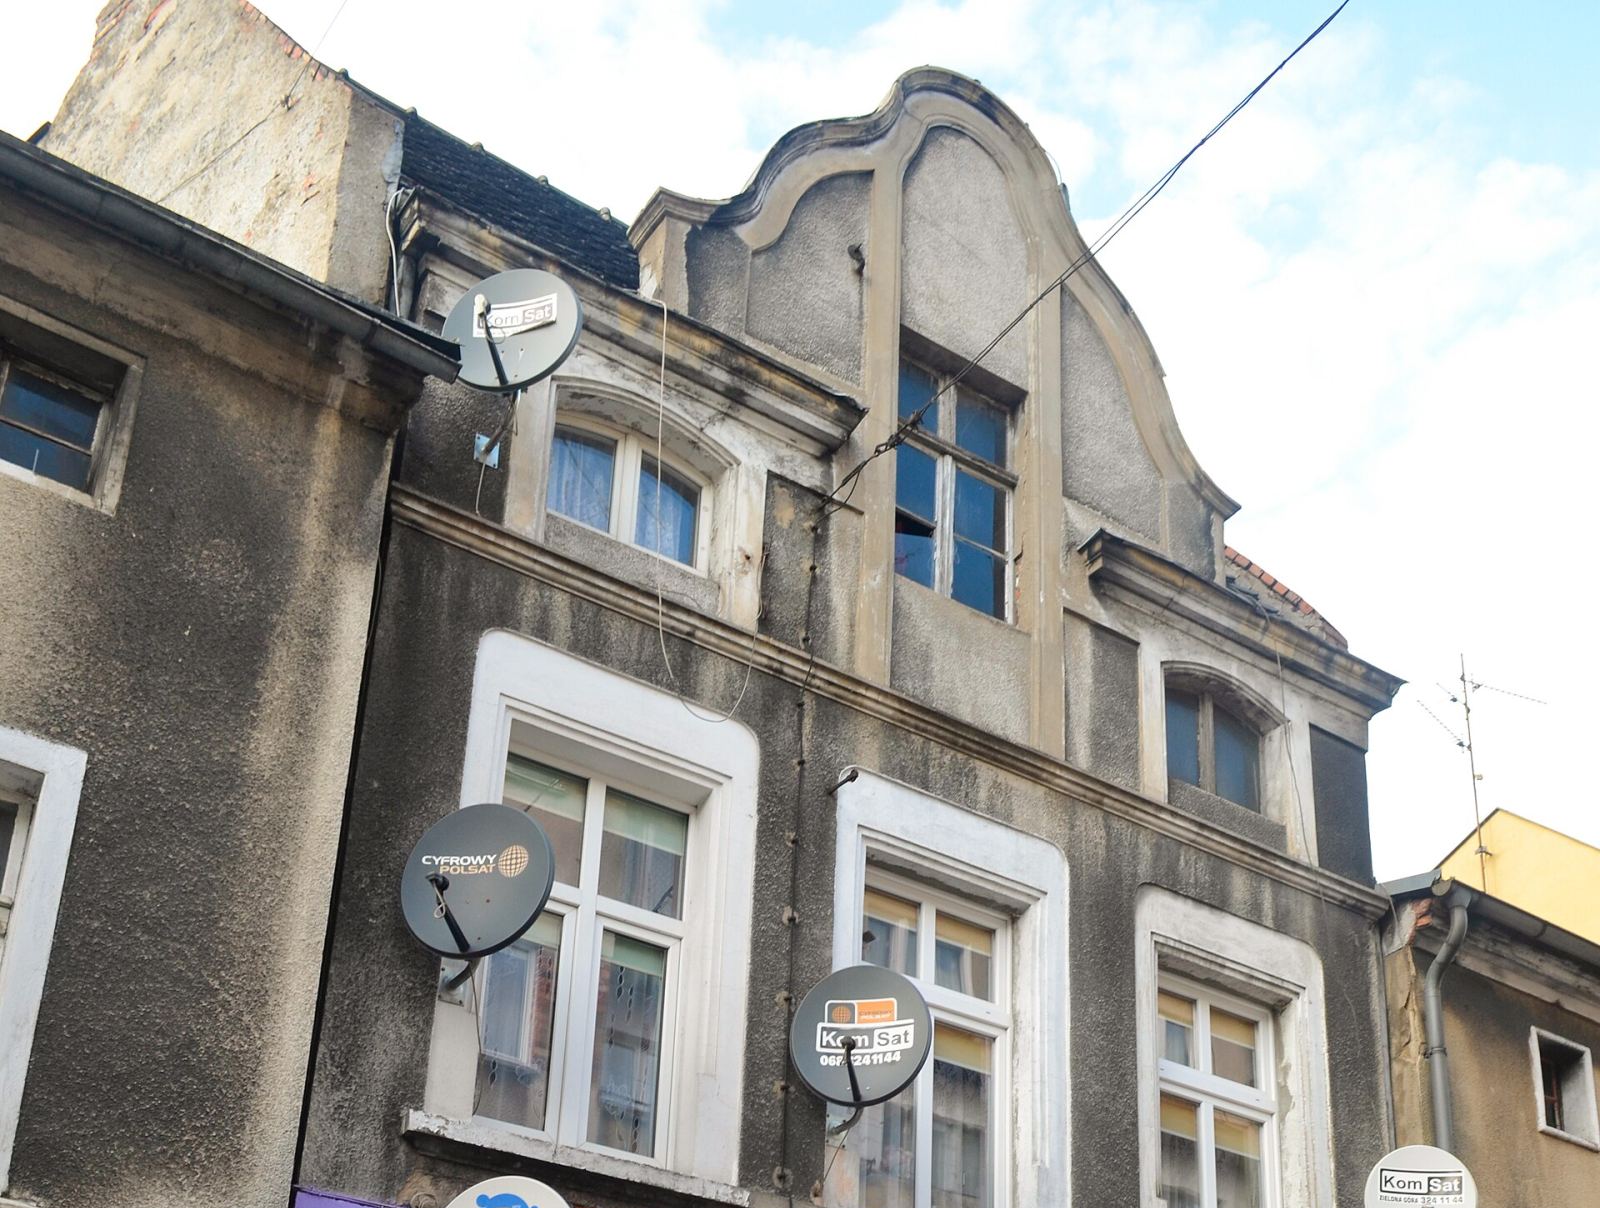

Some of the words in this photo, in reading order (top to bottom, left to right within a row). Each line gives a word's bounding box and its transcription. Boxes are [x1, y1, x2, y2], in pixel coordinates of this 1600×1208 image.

[523, 304, 552, 323] Sat
[421, 854, 497, 866] CYFROWY
[439, 863, 497, 875] POLSAT
[877, 1030, 909, 1047] Sat
[820, 1050, 901, 1066] 068241144
[1384, 1175, 1422, 1190] Kom
[1429, 1178, 1460, 1192] Sat
